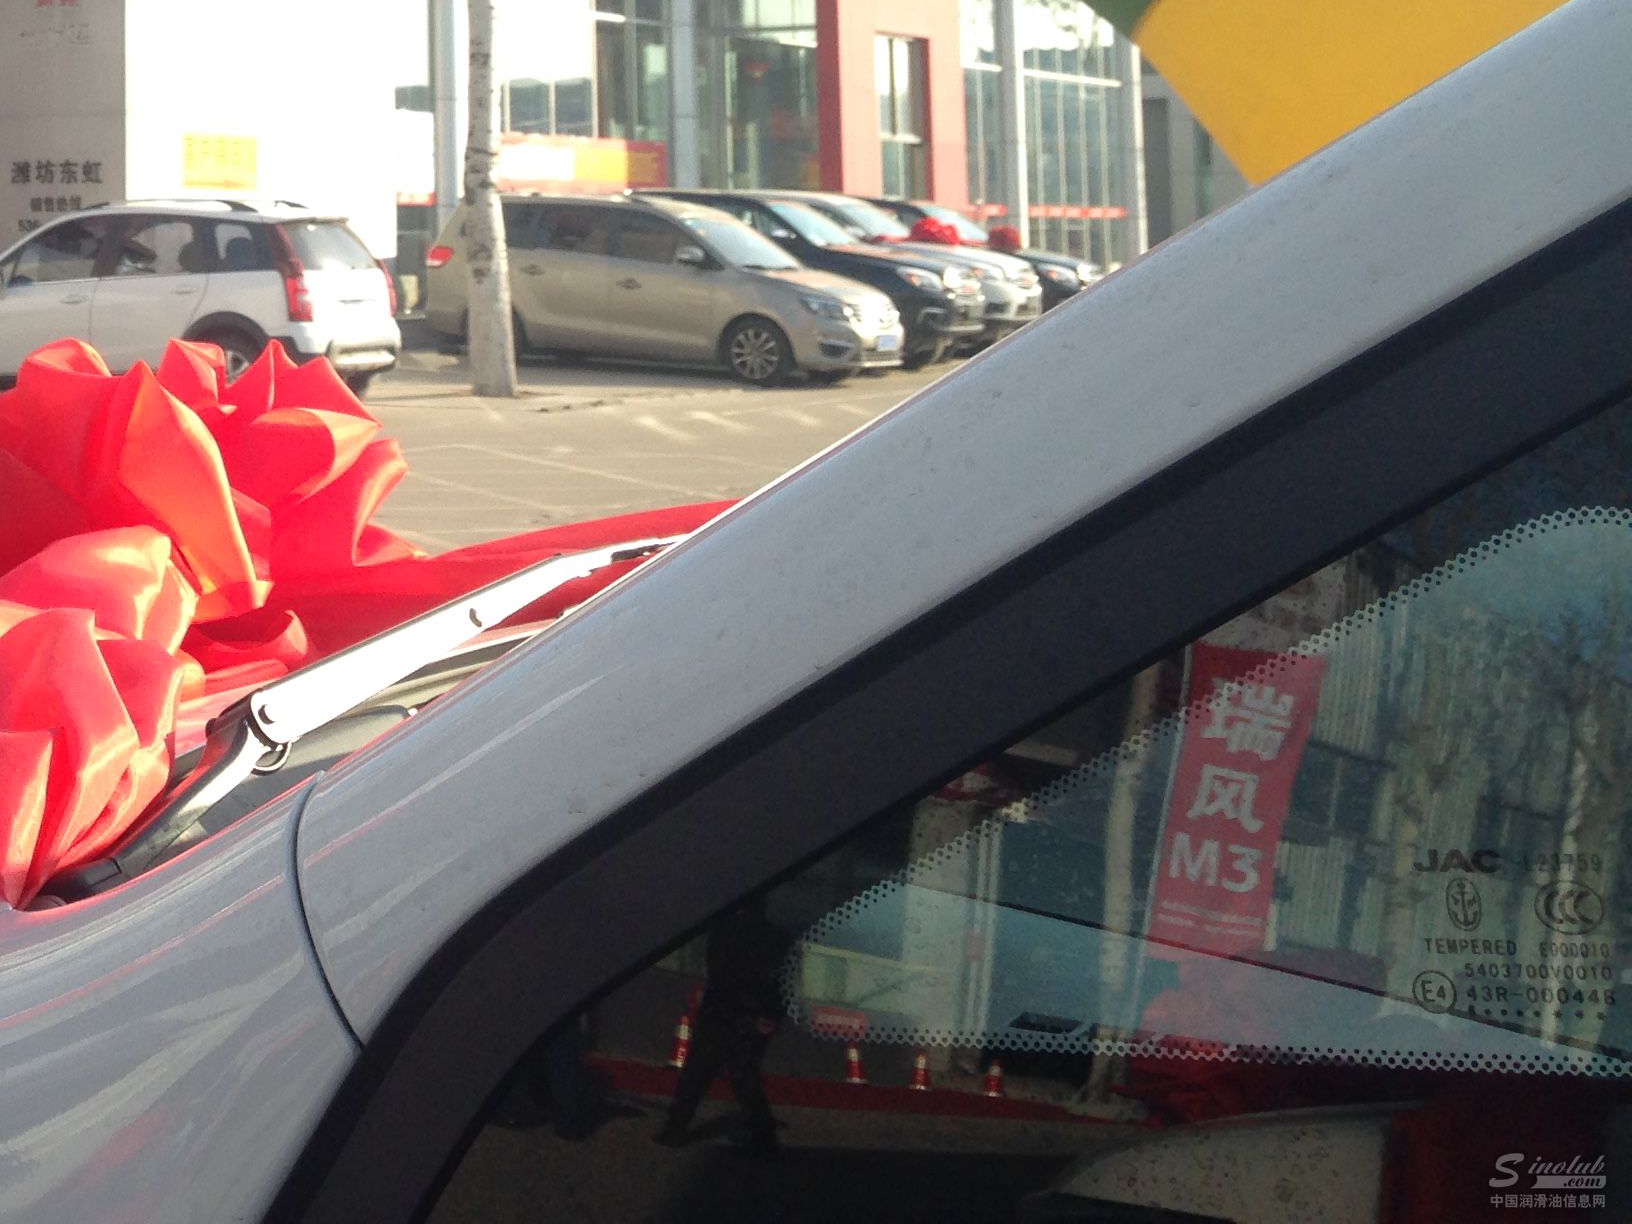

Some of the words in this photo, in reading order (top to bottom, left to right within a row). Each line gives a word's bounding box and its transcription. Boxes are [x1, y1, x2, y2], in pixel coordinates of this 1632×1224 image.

[11, 160, 103, 185] 潍坊东虹
[1413, 848, 1502, 873] JAC
[1424, 938, 1517, 956] TEMPERED
